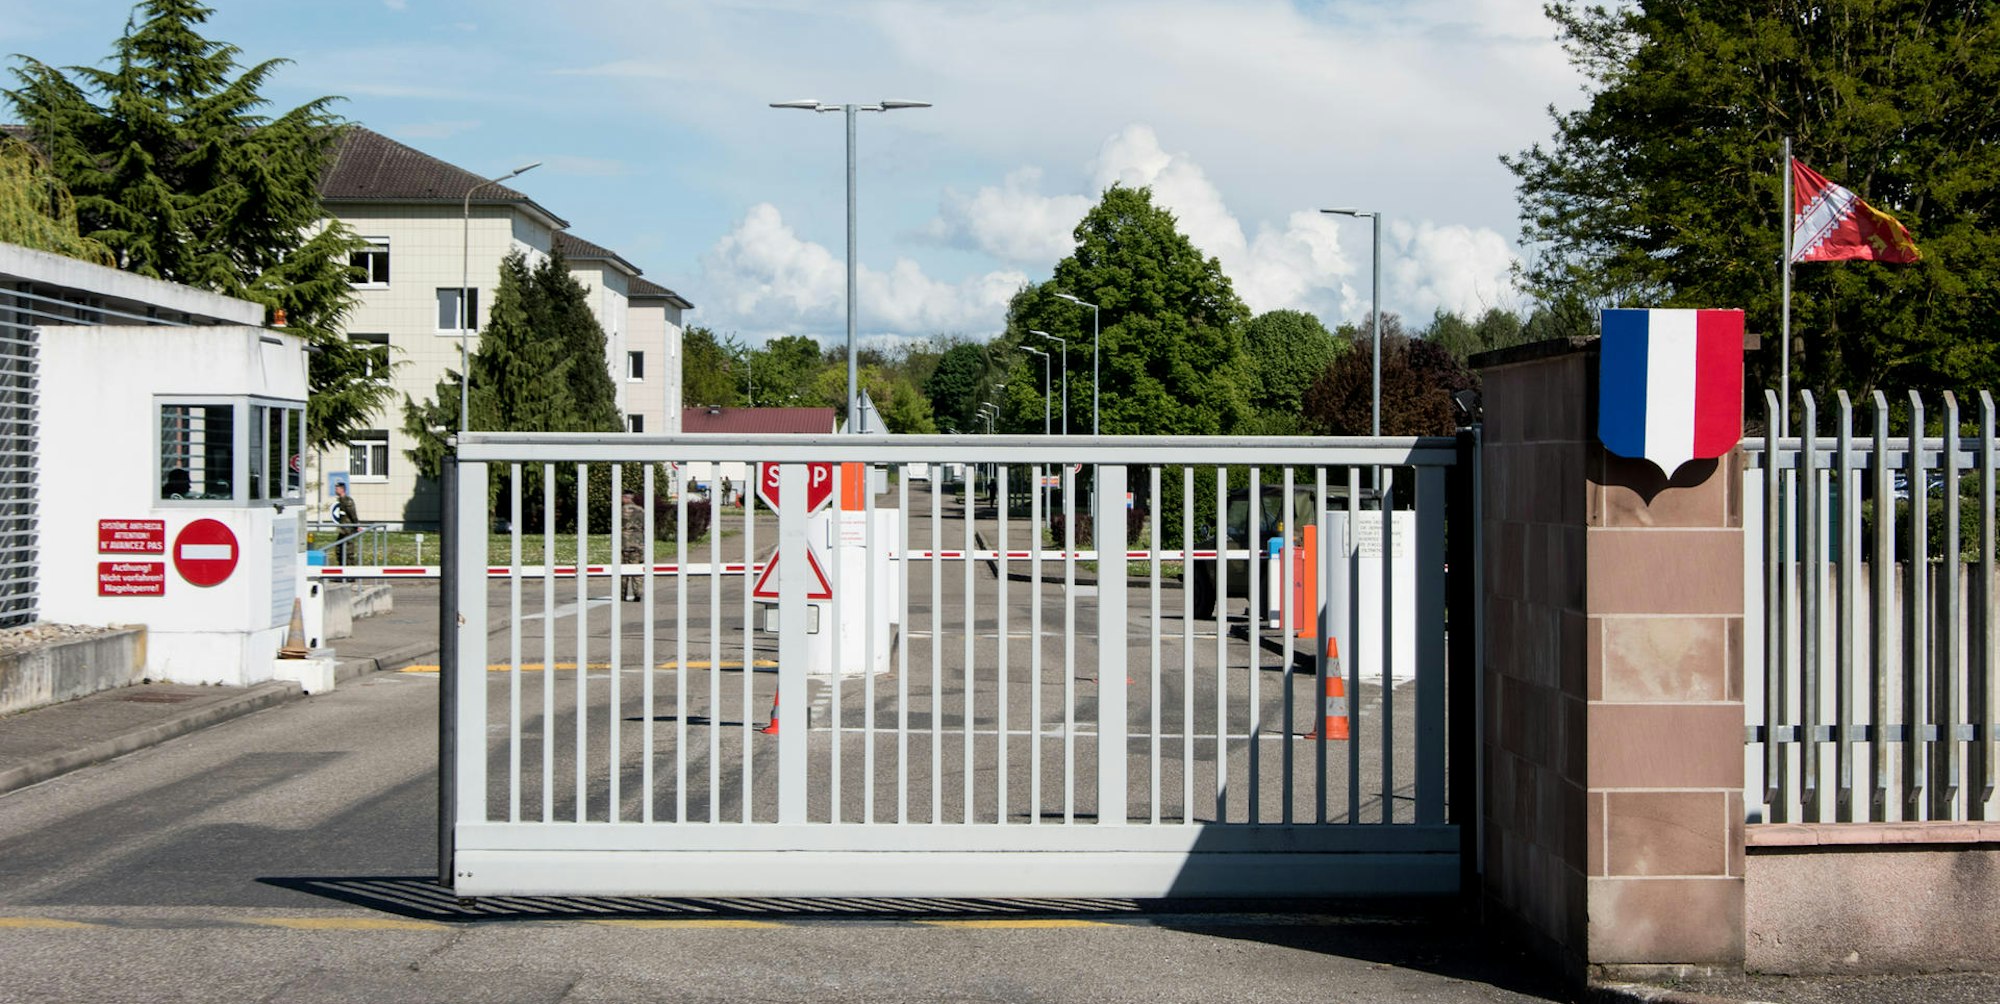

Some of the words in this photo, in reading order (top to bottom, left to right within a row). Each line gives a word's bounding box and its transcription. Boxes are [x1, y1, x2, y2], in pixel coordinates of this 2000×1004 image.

[767, 465, 828, 488] SP
[146, 541, 163, 550] PAS
[100, 573, 121, 582] Nicht
[104, 583, 160, 594] Nagelsperre!
